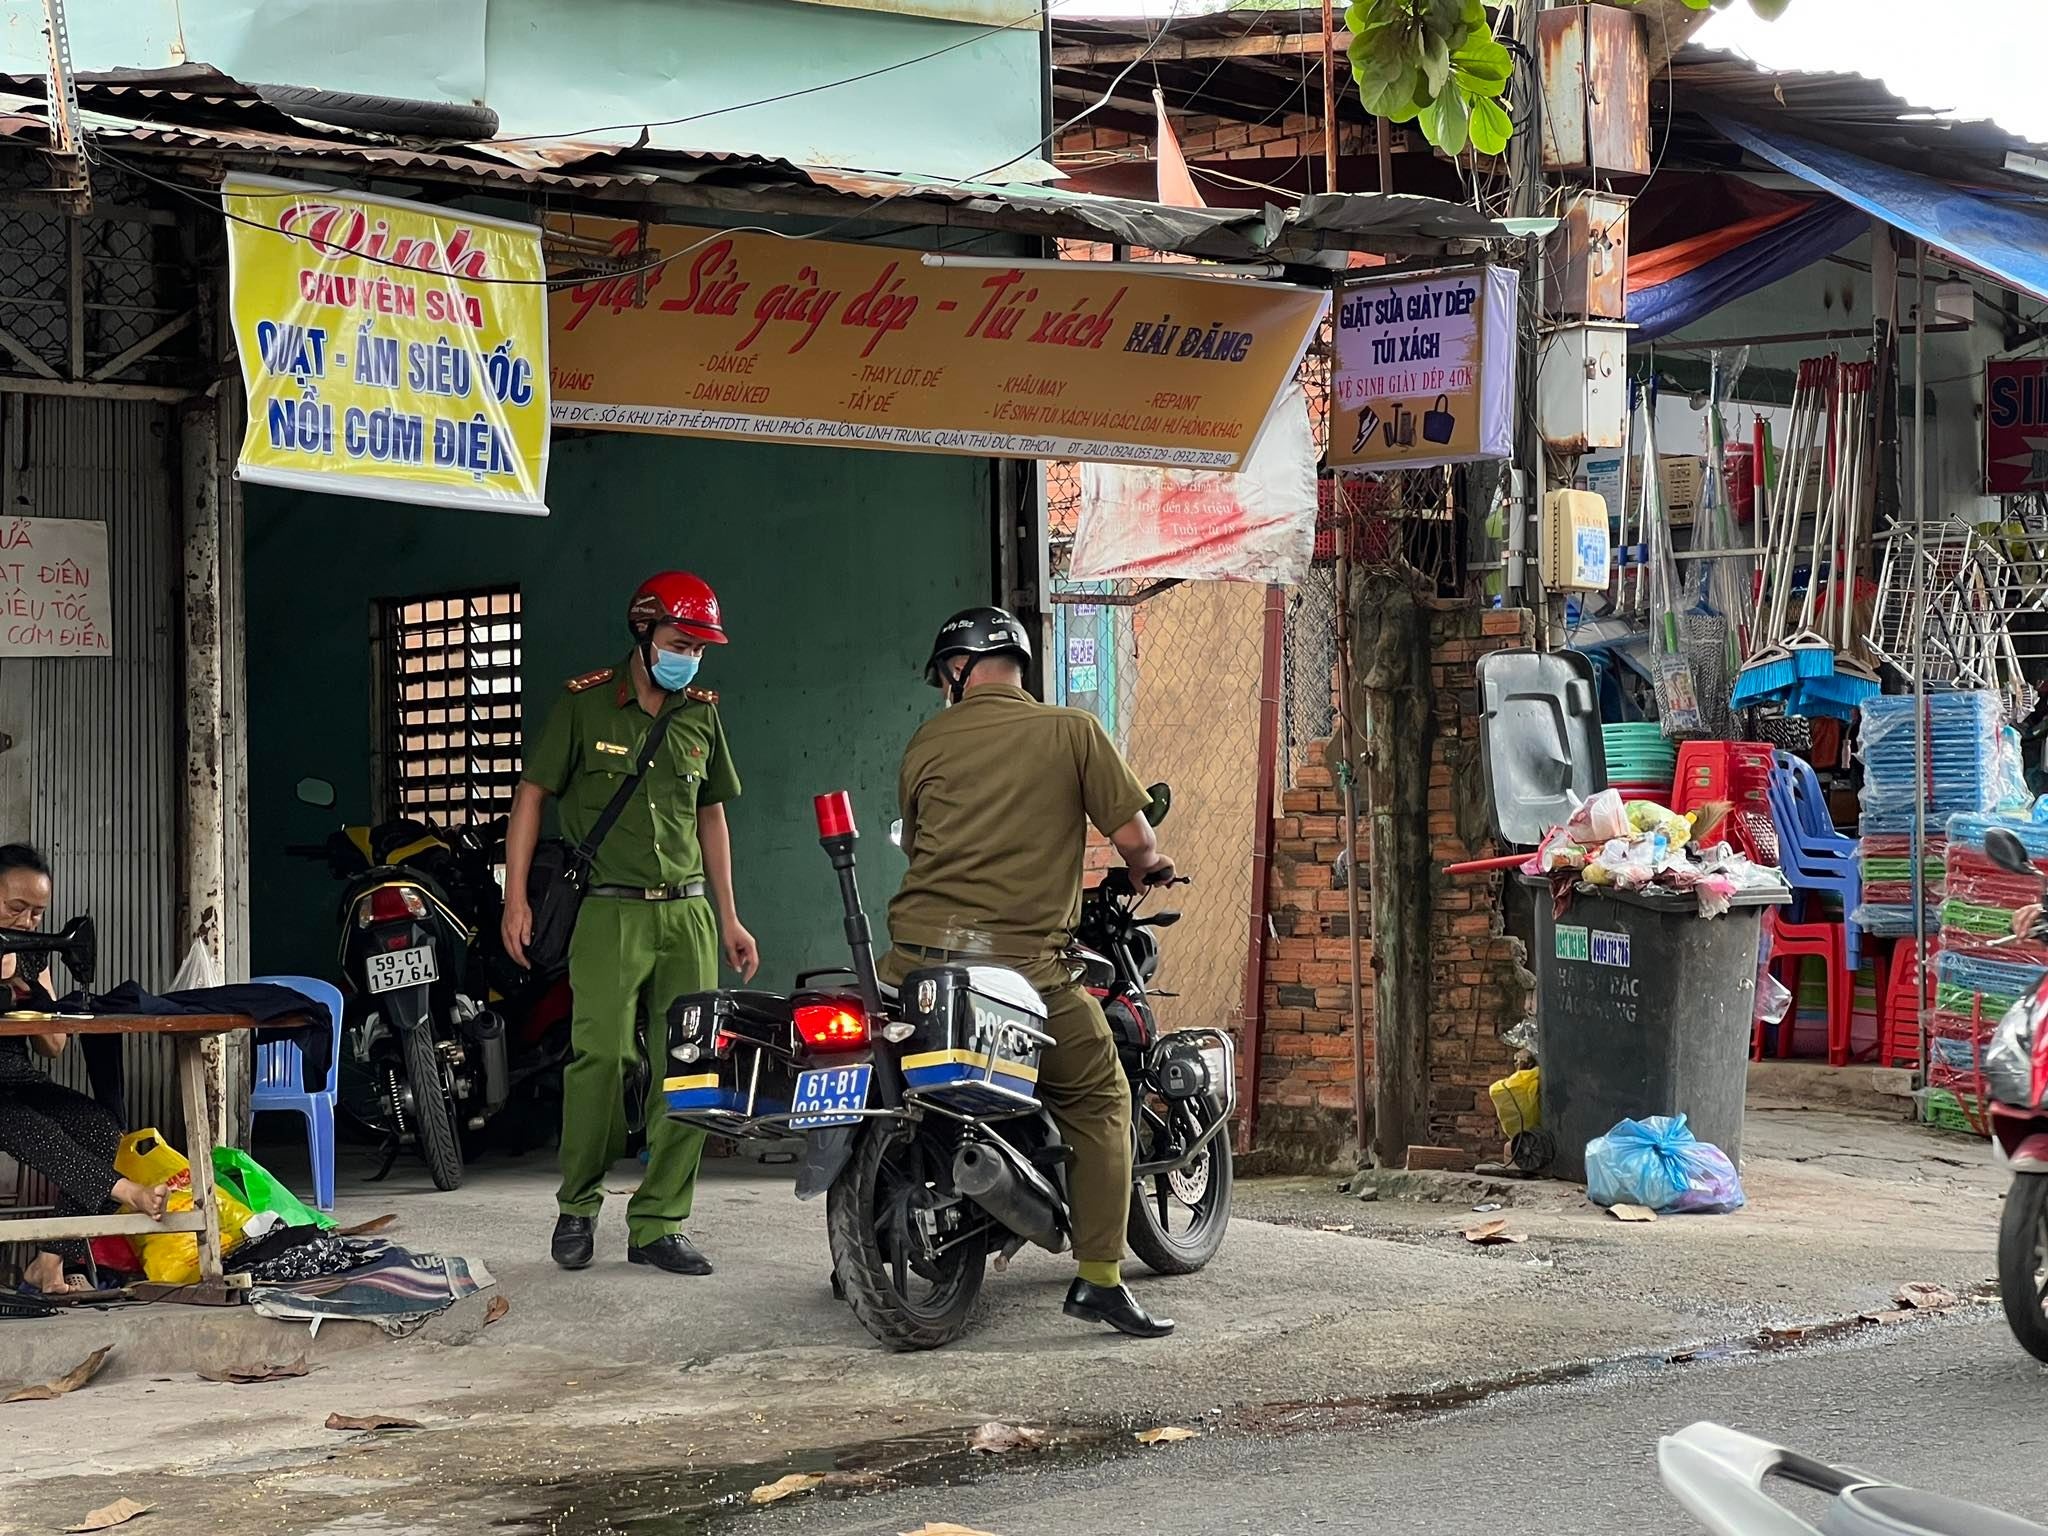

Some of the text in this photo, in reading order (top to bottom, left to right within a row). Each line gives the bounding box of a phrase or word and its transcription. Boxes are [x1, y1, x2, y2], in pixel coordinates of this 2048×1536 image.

[278, 204, 493, 280] Vinh
[300, 270, 415, 317] CHUYÊN
[659, 239, 750, 315] Sửa
[841, 262, 919, 358] dép
[964, 269, 1038, 340] Túi
[1027, 286, 1129, 349] xách
[1123, 314, 1180, 356] HẢI
[1176, 322, 1253, 363] ĐĂNG
[1340, 281, 1476, 333] GIẶT SỬA GIÀY DÉP
[1372, 326, 1441, 365] TÚI XÁCH
[257, 320, 328, 387] QUẠT
[354, 319, 399, 388] ẤM
[408, 336, 472, 398] SIÊU
[475, 338, 533, 407] ỐC
[860, 365, 896, 382] THAY
[1037, 379, 1068, 398] MAY
[1356, 377, 1384, 397] SINH
[1388, 369, 1418, 394] GIÀY
[1423, 367, 1445, 391] DÉP
[1009, 404, 1038, 421] SINH
[1151, 392, 1202, 412] REPAINT
[1991, 376, 2048, 428] SI
[268, 386, 515, 481] NỒI CƠM ĐIỆN
[625, 411, 655, 425] KHU
[753, 419, 781, 434] KHU
[51, 593, 91, 622] TỐC
[7, 623, 53, 645] CƠM
[375, 950, 422, 972] 59-C1
[371, 964, 433, 989] 157.64
[807, 1069, 859, 1098] 61-B1
